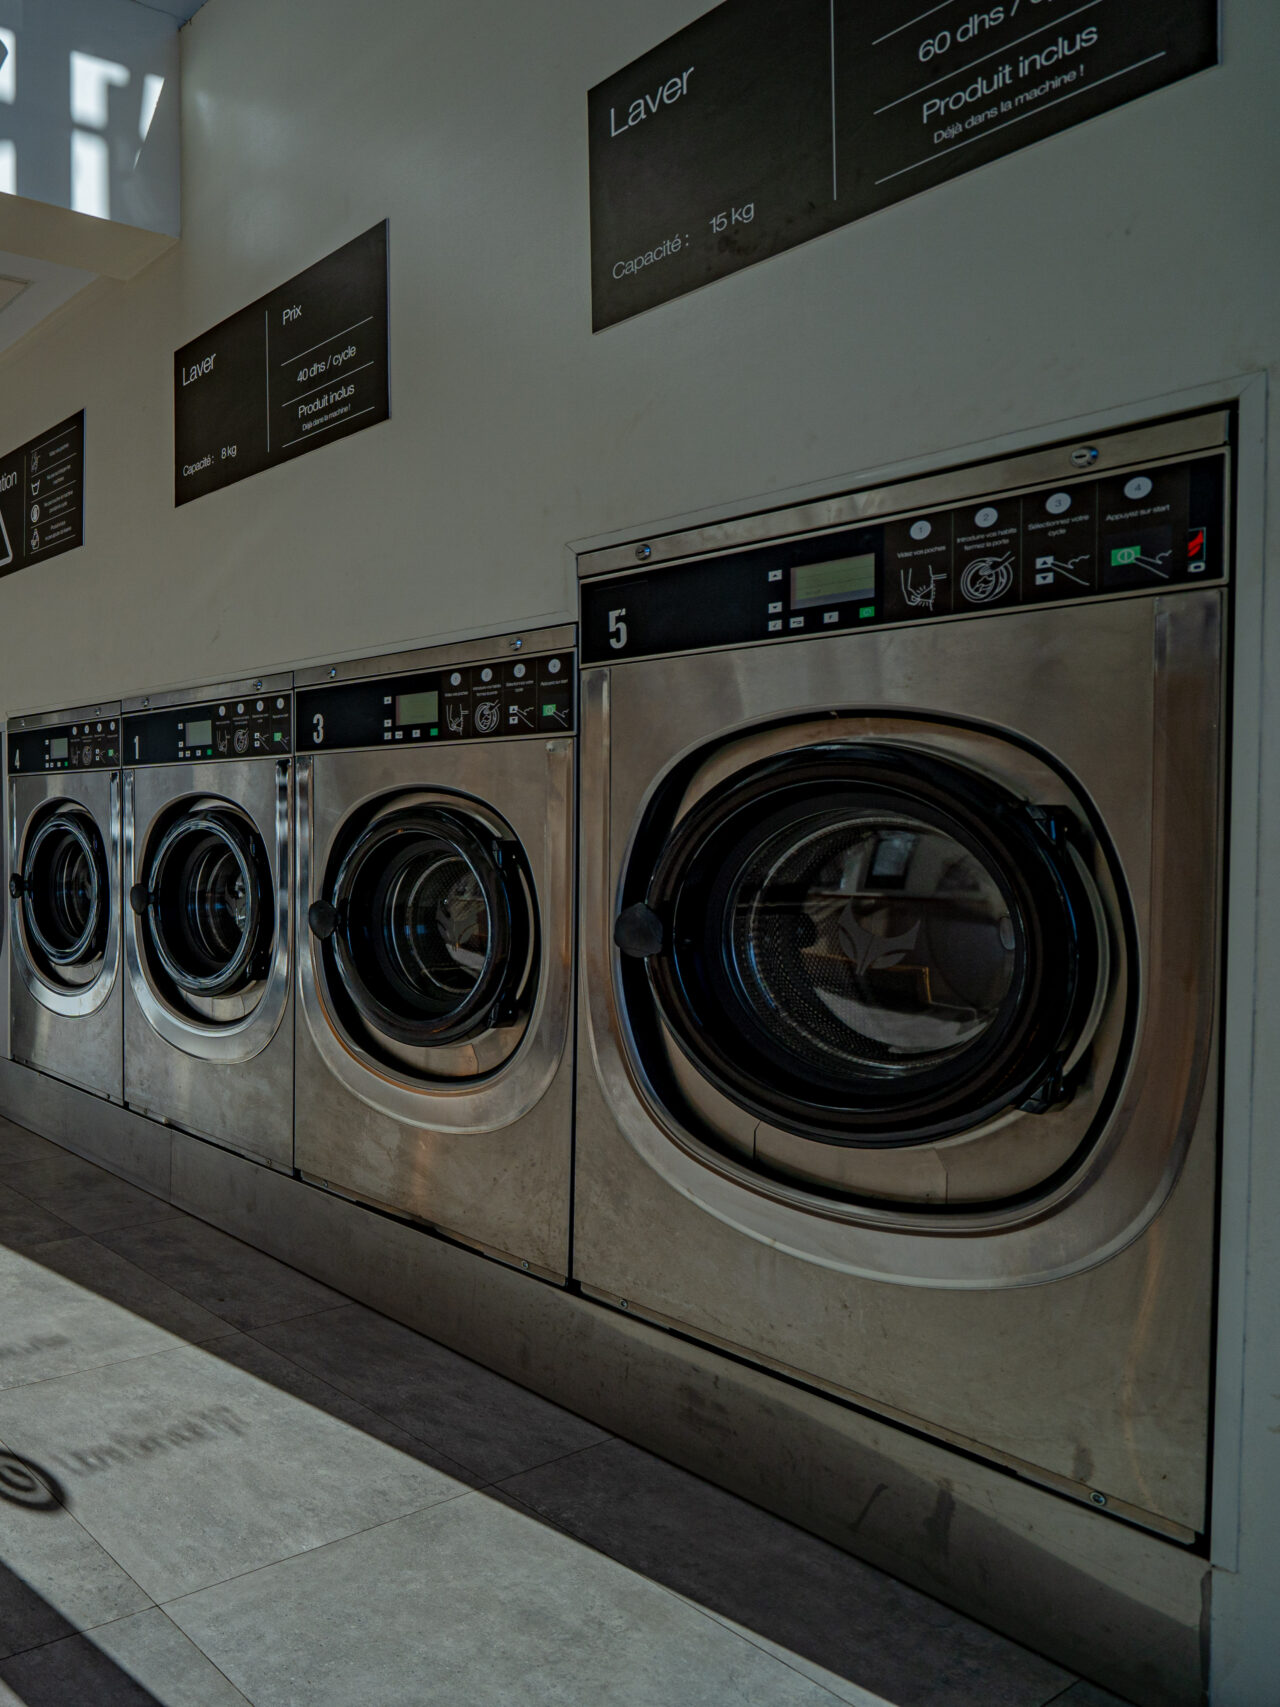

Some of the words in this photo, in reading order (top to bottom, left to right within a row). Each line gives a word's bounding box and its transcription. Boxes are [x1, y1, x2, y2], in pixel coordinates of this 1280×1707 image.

[918, 30, 951, 63] 60
[955, 4, 1005, 44] dhs
[922, 64, 1013, 125] Produit
[1018, 26, 1099, 79] inclus
[610, 65, 695, 138] Laver
[933, 120, 963, 145] Déjà
[965, 106, 998, 131] dans
[1000, 100, 1012, 114] la
[1014, 72, 1077, 108] machine
[612, 233, 682, 280] Capacité
[709, 213, 728, 234] 15
[731, 202, 755, 225] kg
[282, 304, 302, 326] Prix
[182, 353, 217, 387] Laver
[297, 368, 308, 382] 40
[309, 361, 326, 377] dhs
[332, 345, 357, 366] cycle
[298, 394, 328, 419] Produit
[329, 384, 355, 404] inclus
[182, 454, 211, 477] Capacité
[221, 447, 227, 460] 8
[227, 444, 238, 460] kg
[608, 608, 628, 649] 5
[312, 713, 324, 744] 3
[14, 748, 20, 769] 4
[133, 735, 139, 760] 1
